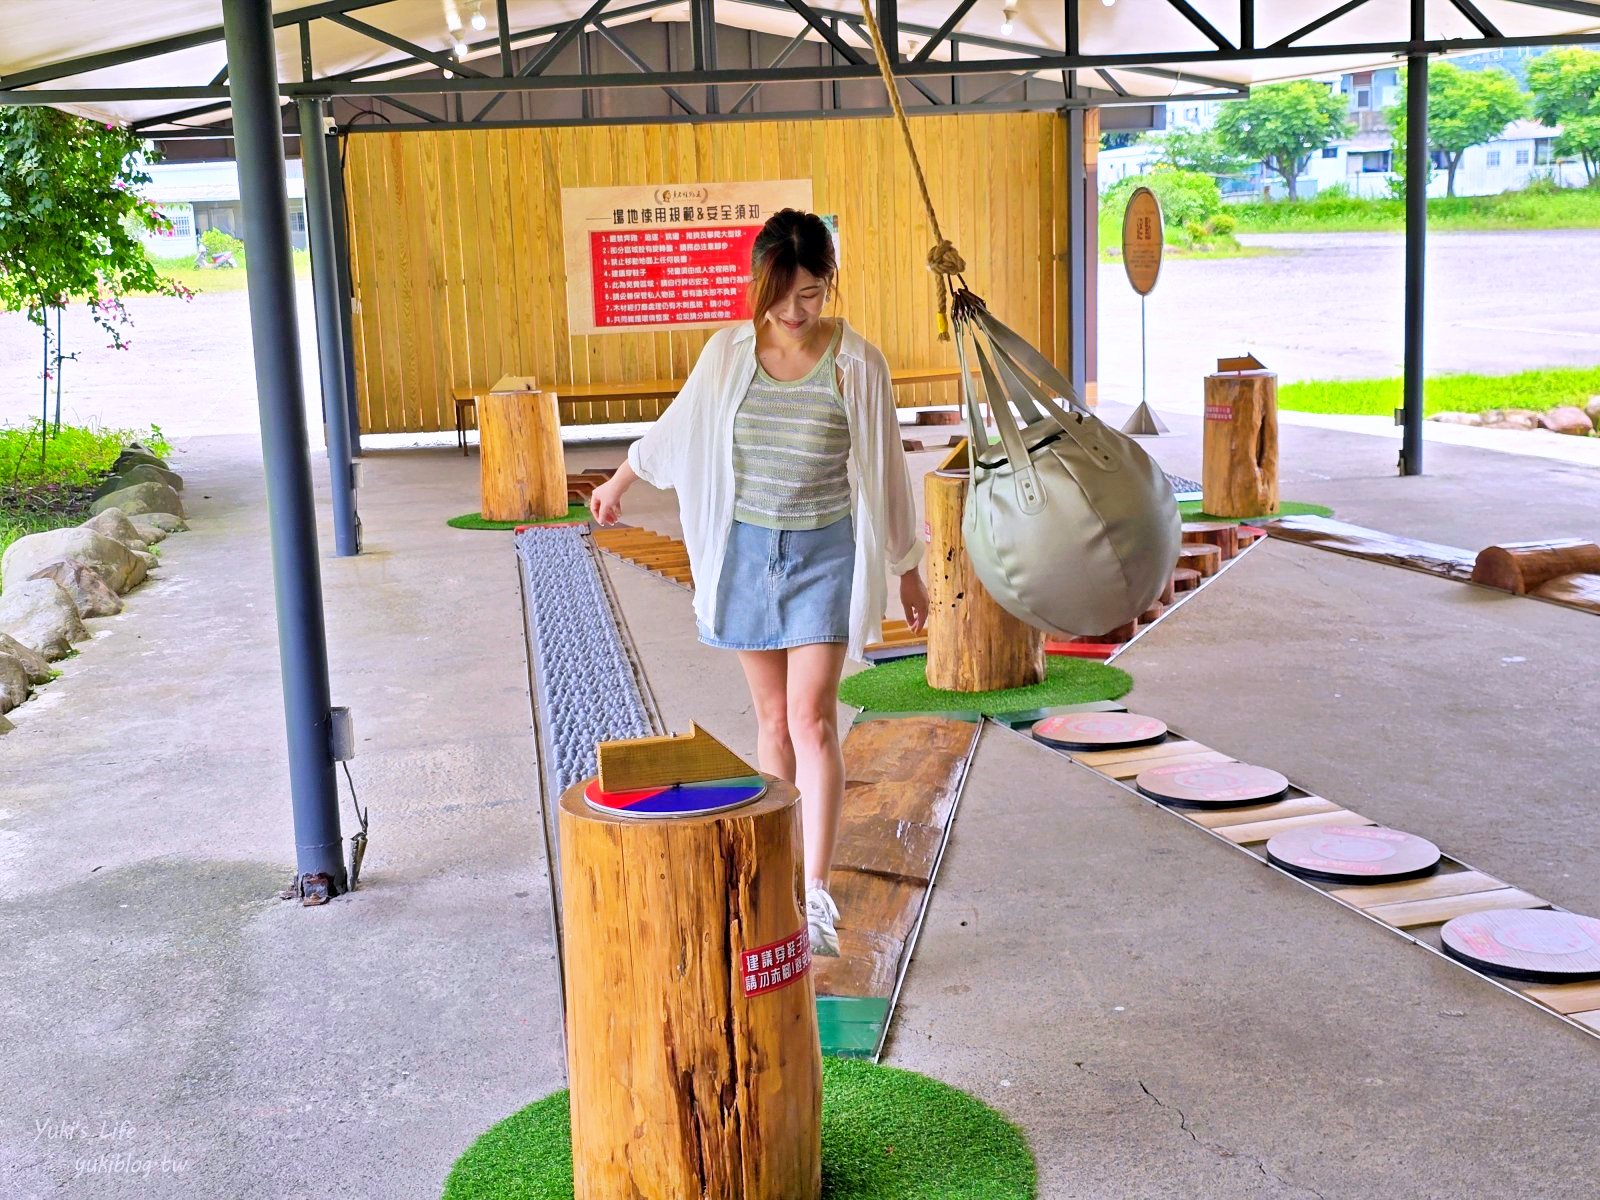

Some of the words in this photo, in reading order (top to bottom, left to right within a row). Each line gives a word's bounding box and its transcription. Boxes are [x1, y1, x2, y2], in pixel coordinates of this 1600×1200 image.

[612, 203, 761, 225] 場地使用規範&安全須知
